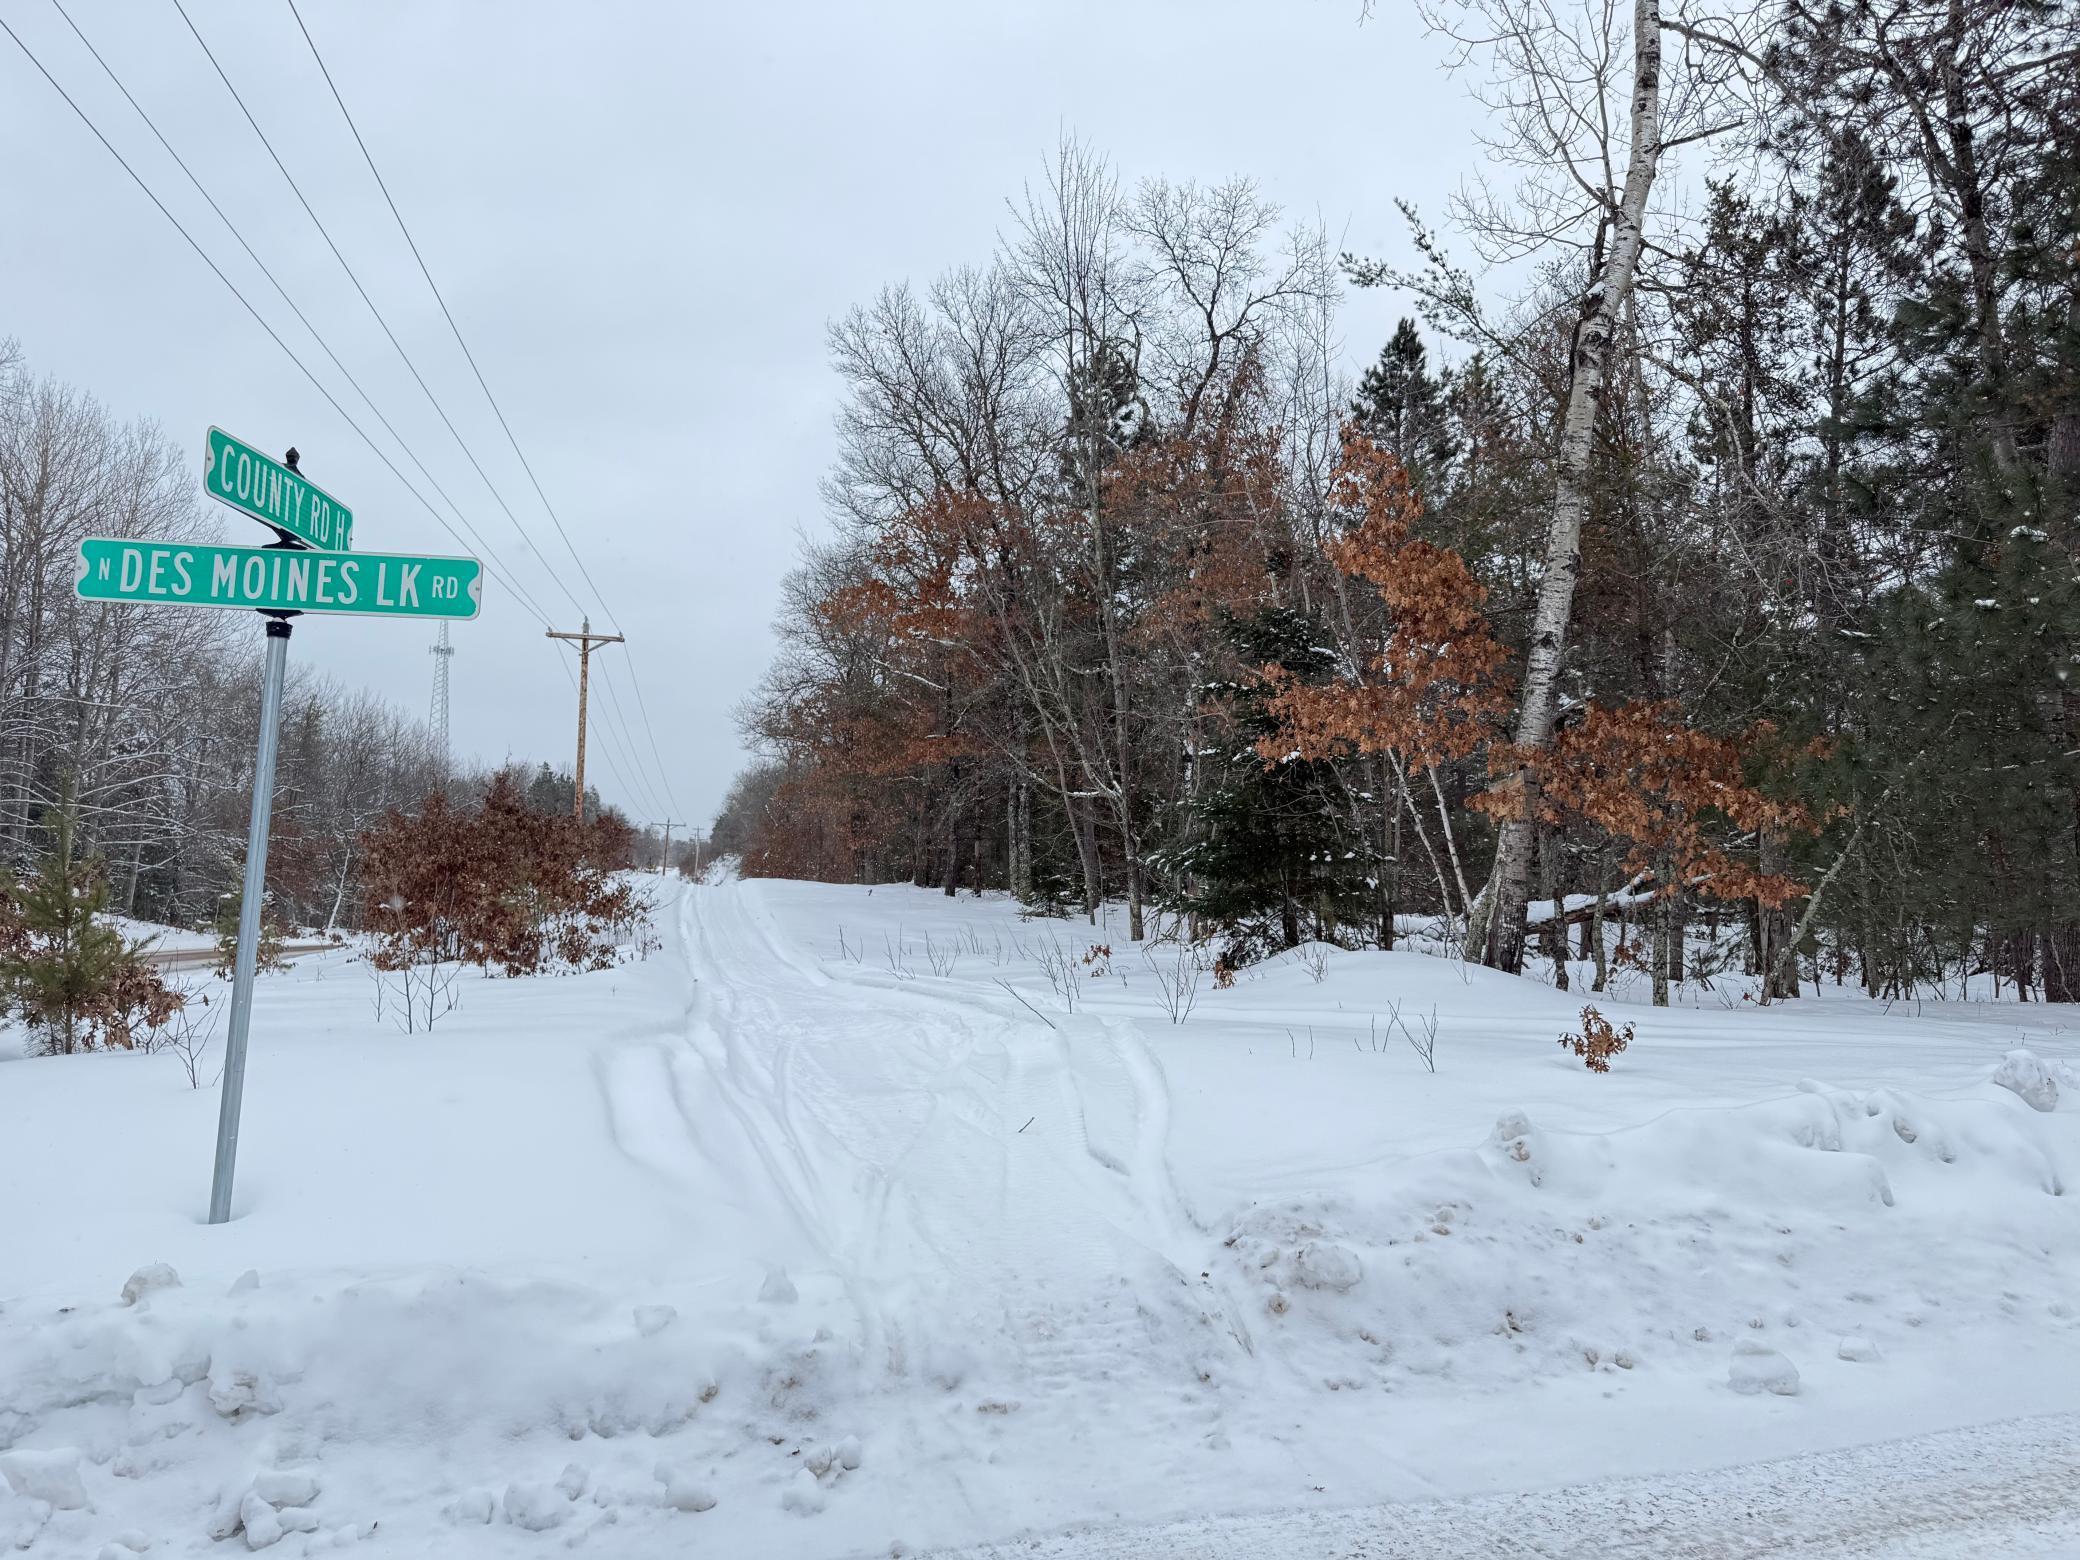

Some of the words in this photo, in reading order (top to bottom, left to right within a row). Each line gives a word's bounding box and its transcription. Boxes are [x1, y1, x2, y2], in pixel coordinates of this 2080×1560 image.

[221, 445, 305, 526] COUNTY
[310, 494, 330, 543] RD
[335, 511, 345, 551] H
[99, 557, 111, 580] N
[119, 548, 194, 596] DES
[211, 554, 360, 605] MOINES
[376, 563, 423, 608] LK
[432, 575, 459, 599] RD
